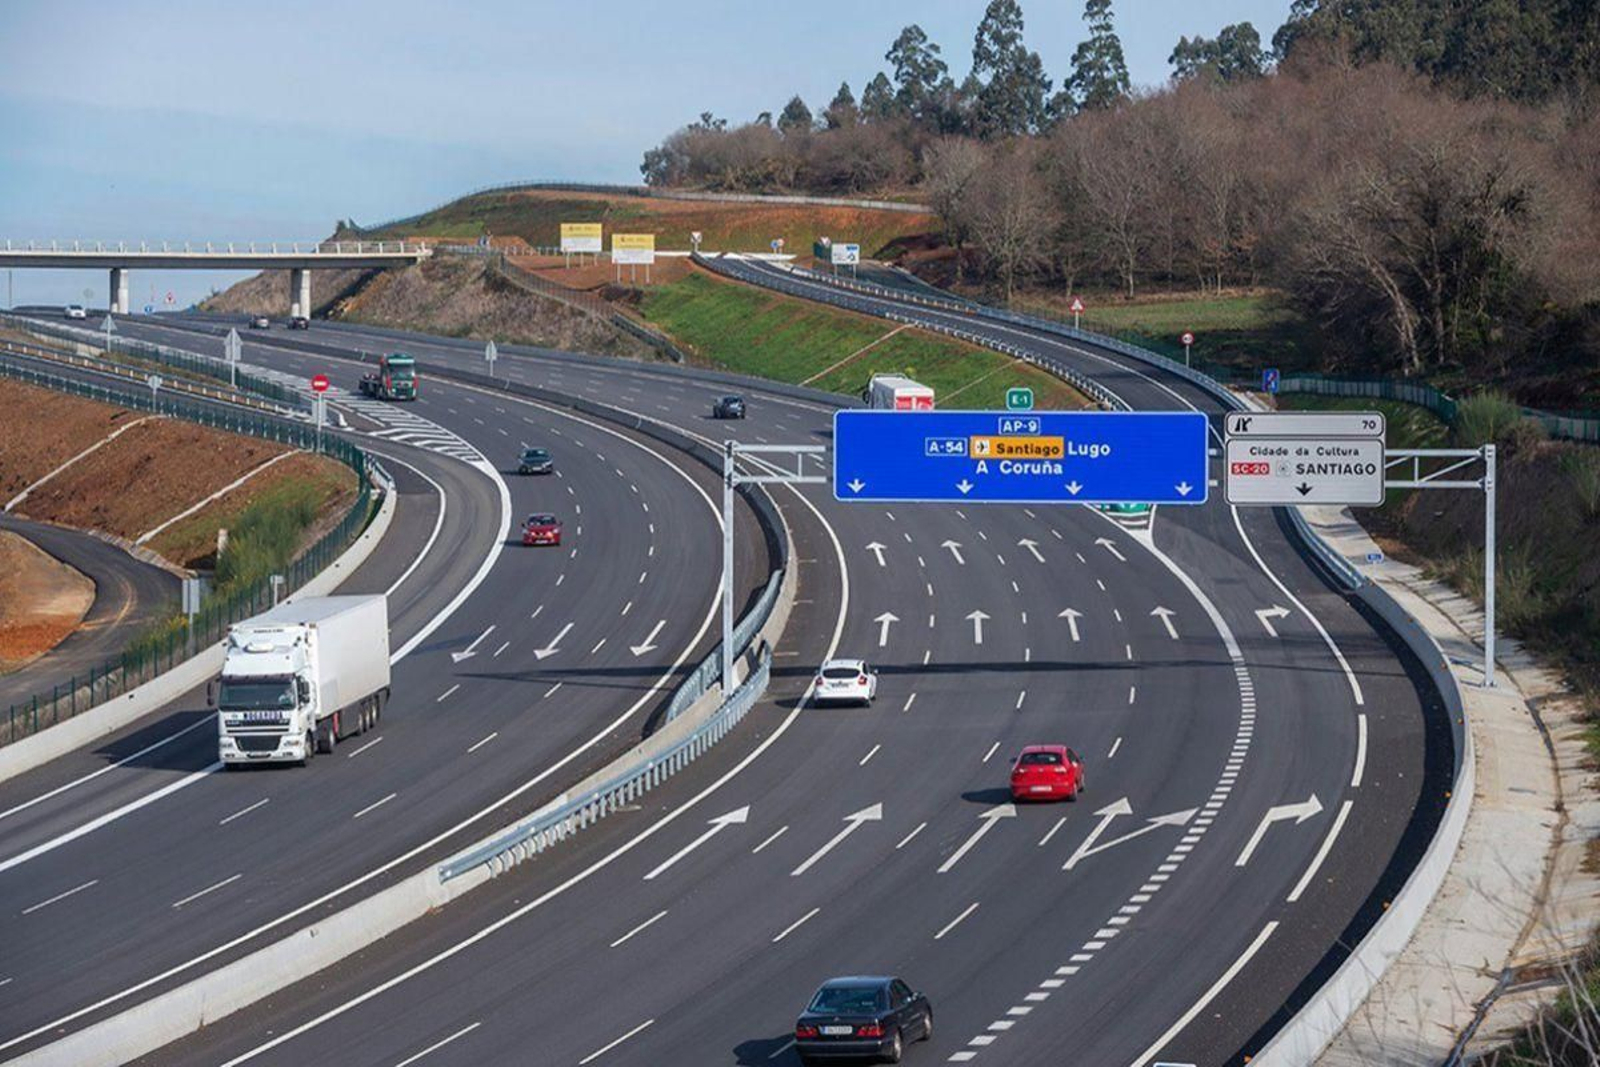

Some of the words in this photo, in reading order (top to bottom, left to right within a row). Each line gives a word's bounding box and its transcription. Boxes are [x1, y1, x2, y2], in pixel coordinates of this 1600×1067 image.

[1002, 420, 1037, 433] AP-9
[1361, 420, 1376, 430] 70
[928, 441, 964, 453] A-54
[996, 443, 1060, 457] Santiago
[1068, 441, 1111, 458] Lugo
[1249, 446, 1289, 456] Cidade
[1295, 446, 1309, 456] da
[1316, 446, 1359, 456] Cultura
[976, 460, 989, 474] A
[999, 460, 1063, 475] Coruña
[1232, 464, 1269, 474] SC-20
[1295, 463, 1376, 475] SANTIAGO
